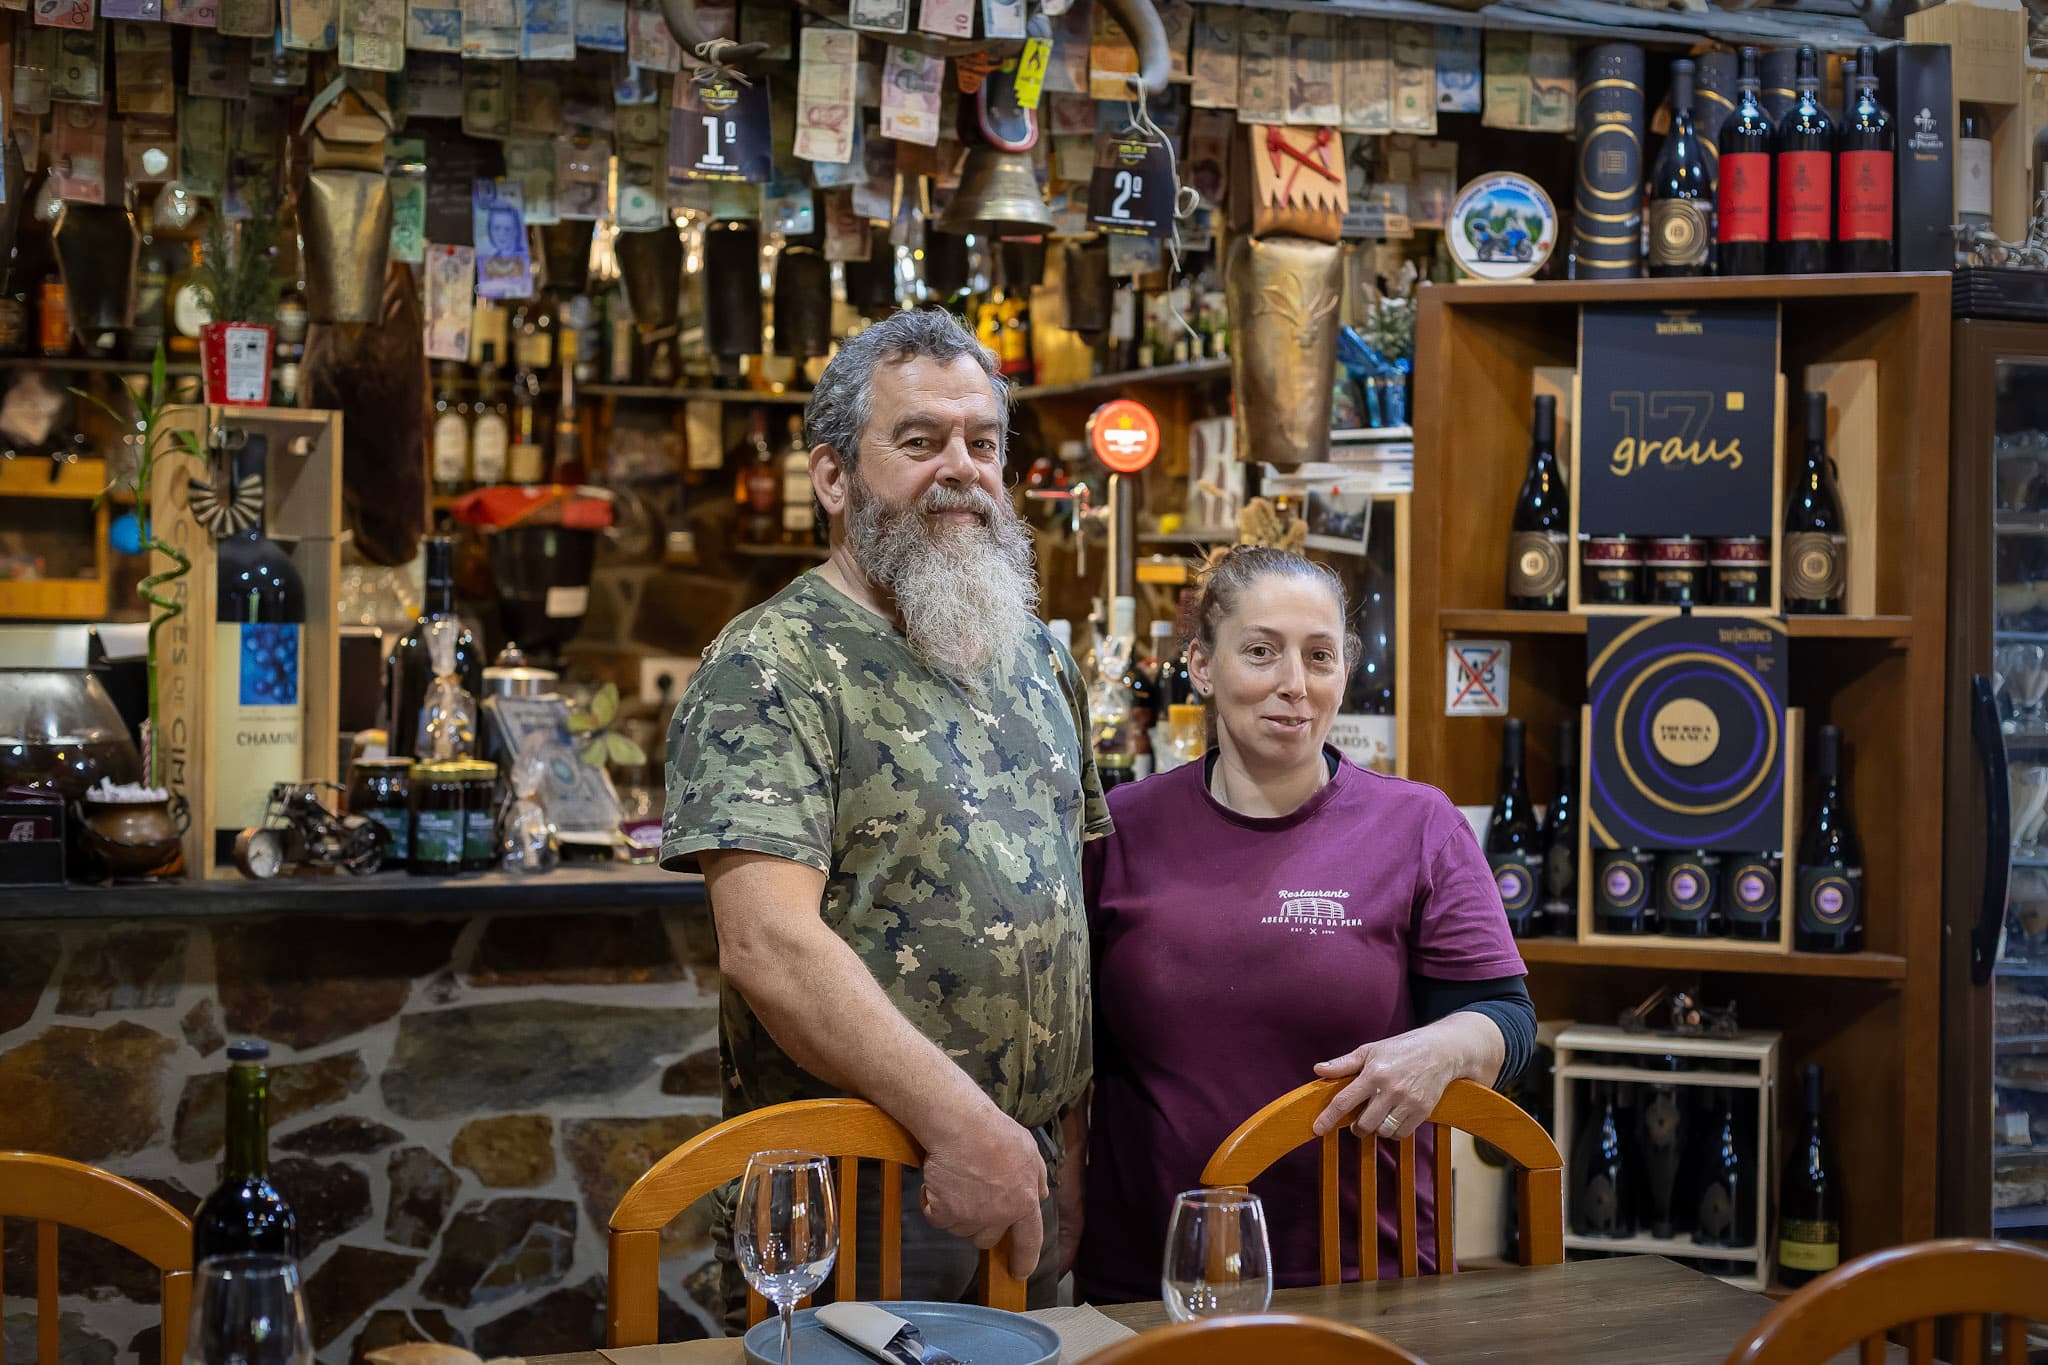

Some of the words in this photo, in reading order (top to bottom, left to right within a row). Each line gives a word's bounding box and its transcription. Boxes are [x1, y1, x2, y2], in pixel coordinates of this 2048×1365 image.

[1610, 437, 1743, 476] graus
[172, 518, 188, 666] CRTES
[236, 731, 298, 747] CHAMIN
[1278, 889, 1350, 898] Restaurante
